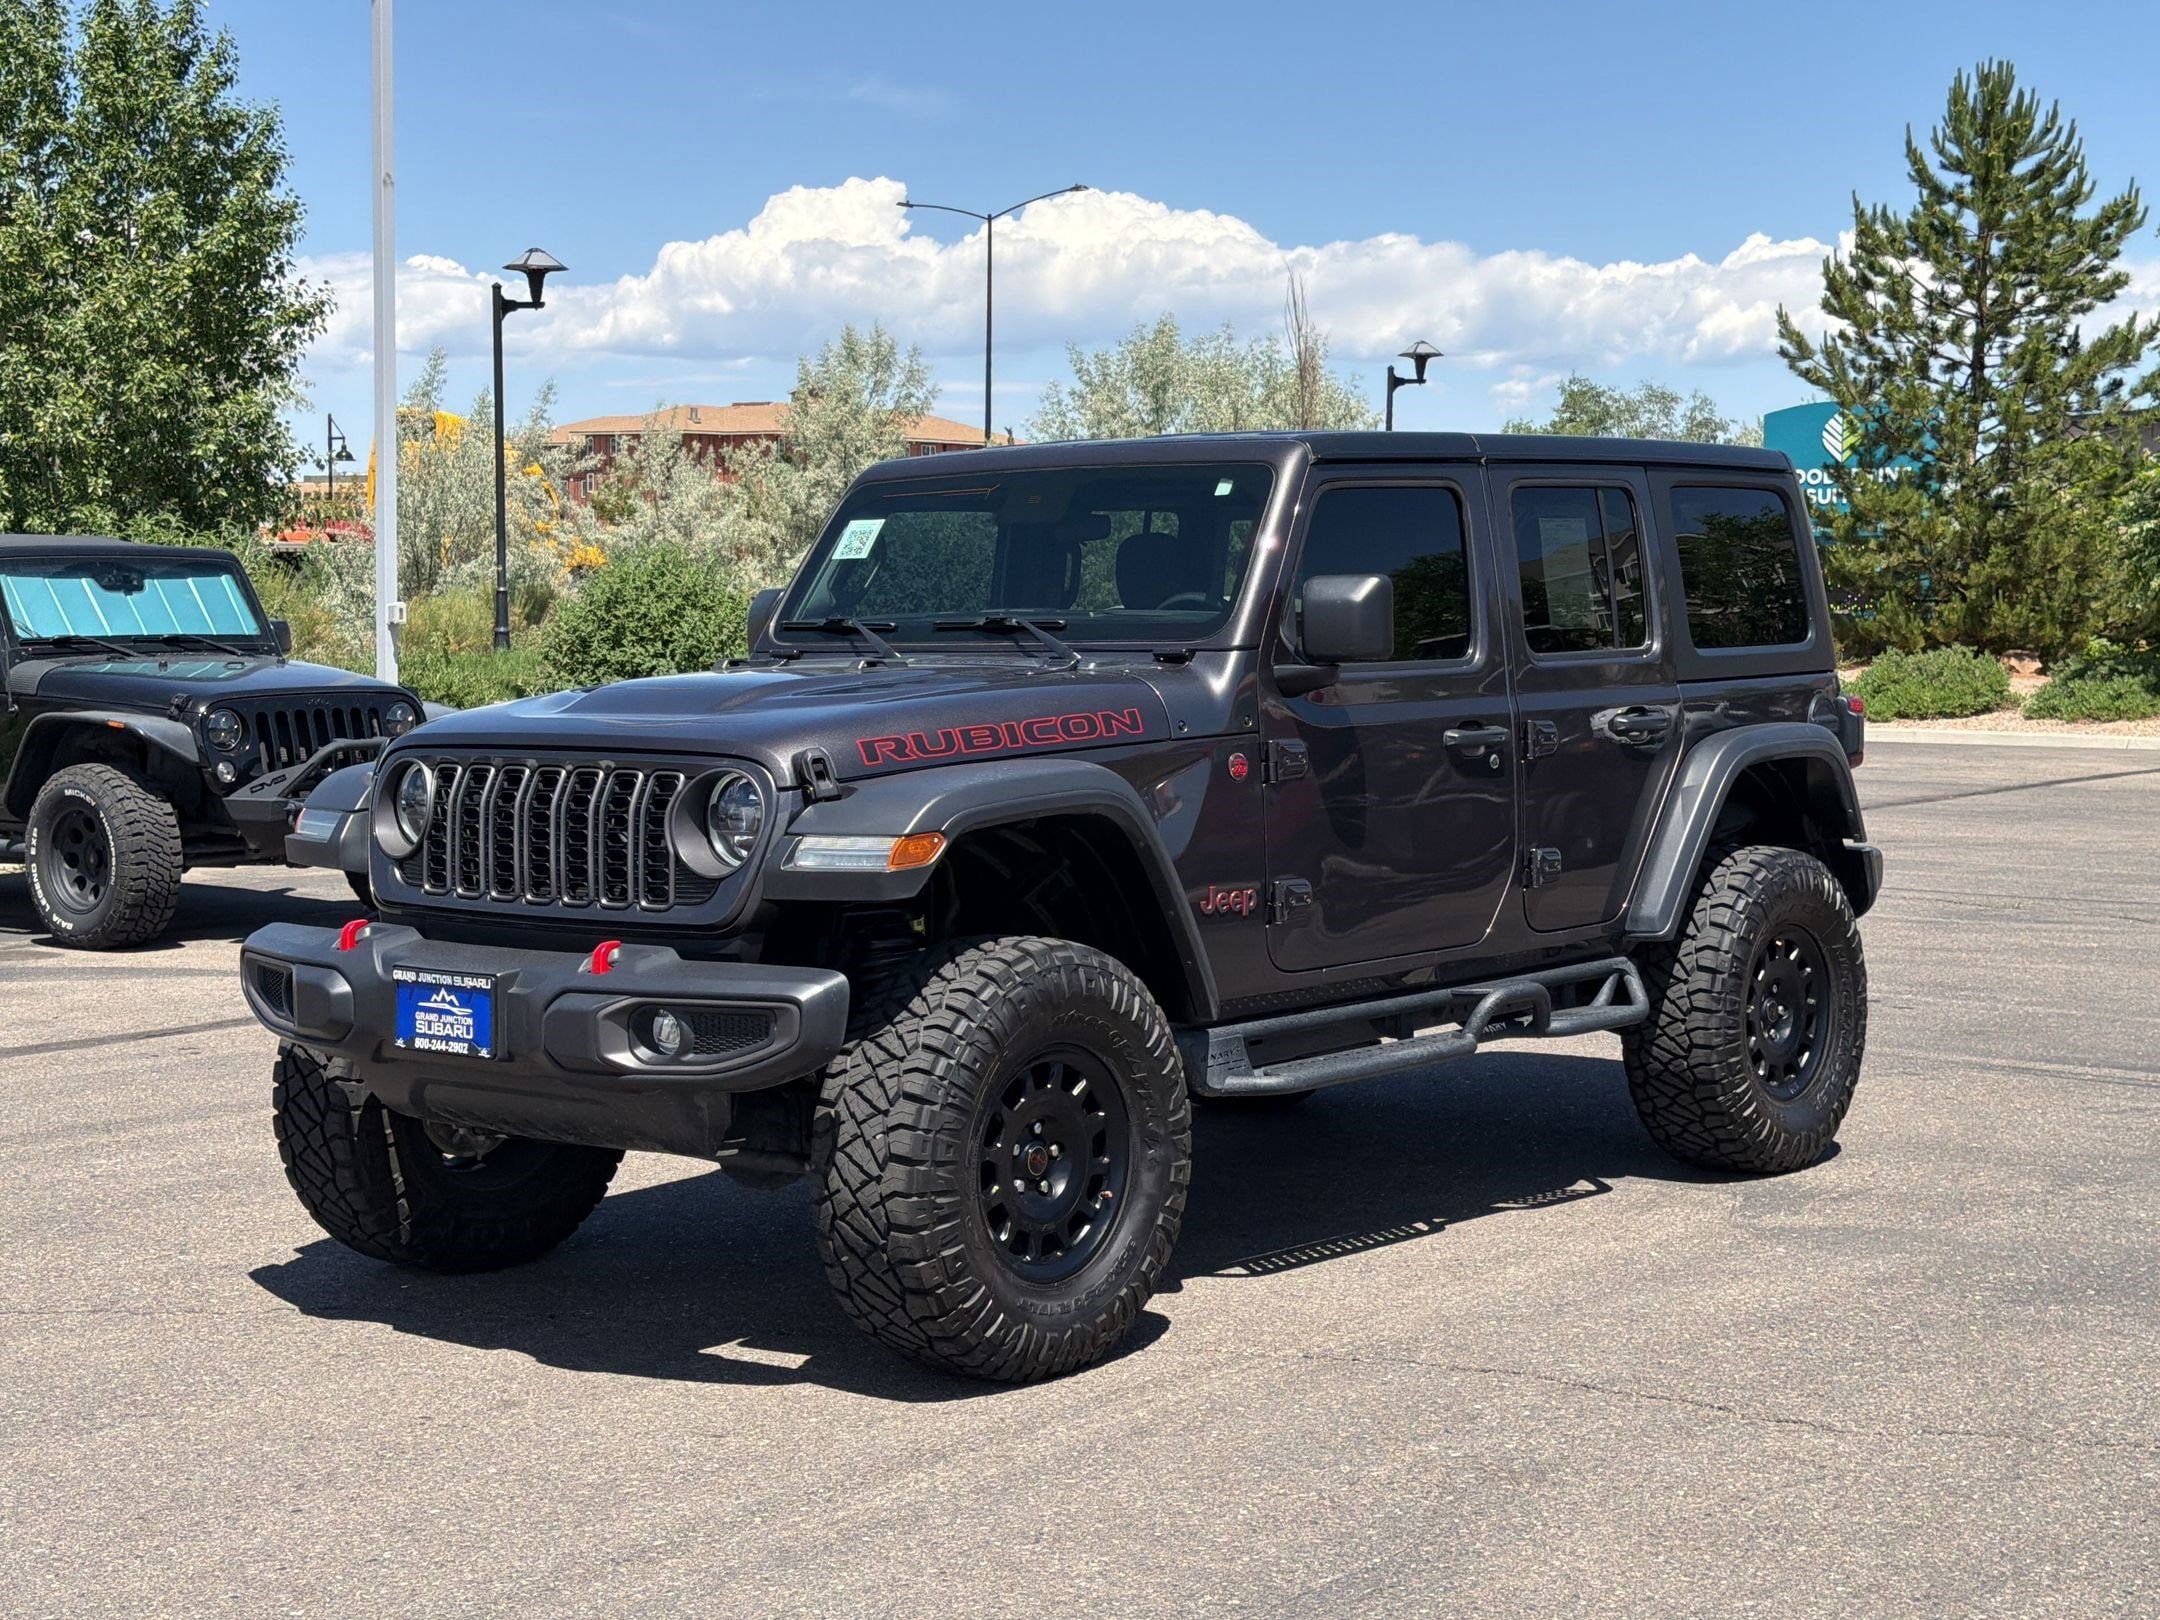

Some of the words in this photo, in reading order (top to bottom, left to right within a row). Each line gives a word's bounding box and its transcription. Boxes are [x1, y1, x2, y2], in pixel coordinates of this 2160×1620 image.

[857, 708, 1144, 766] RUBICON
[64, 788, 96, 807] MICKEY
[99, 810, 117, 886] THOMPSON
[1200, 886, 1257, 917] Jeep
[52, 913, 73, 931] BAJA
[393, 970, 416, 983] GRAND
[418, 972, 452, 985] JUNCTION
[453, 976, 491, 989] SUBARU
[415, 1011, 439, 1022] GRAND
[440, 1014, 473, 1025] JUNCTION
[416, 1020, 473, 1039] SUBARU
[414, 1037, 468, 1054] 800-244-2902
